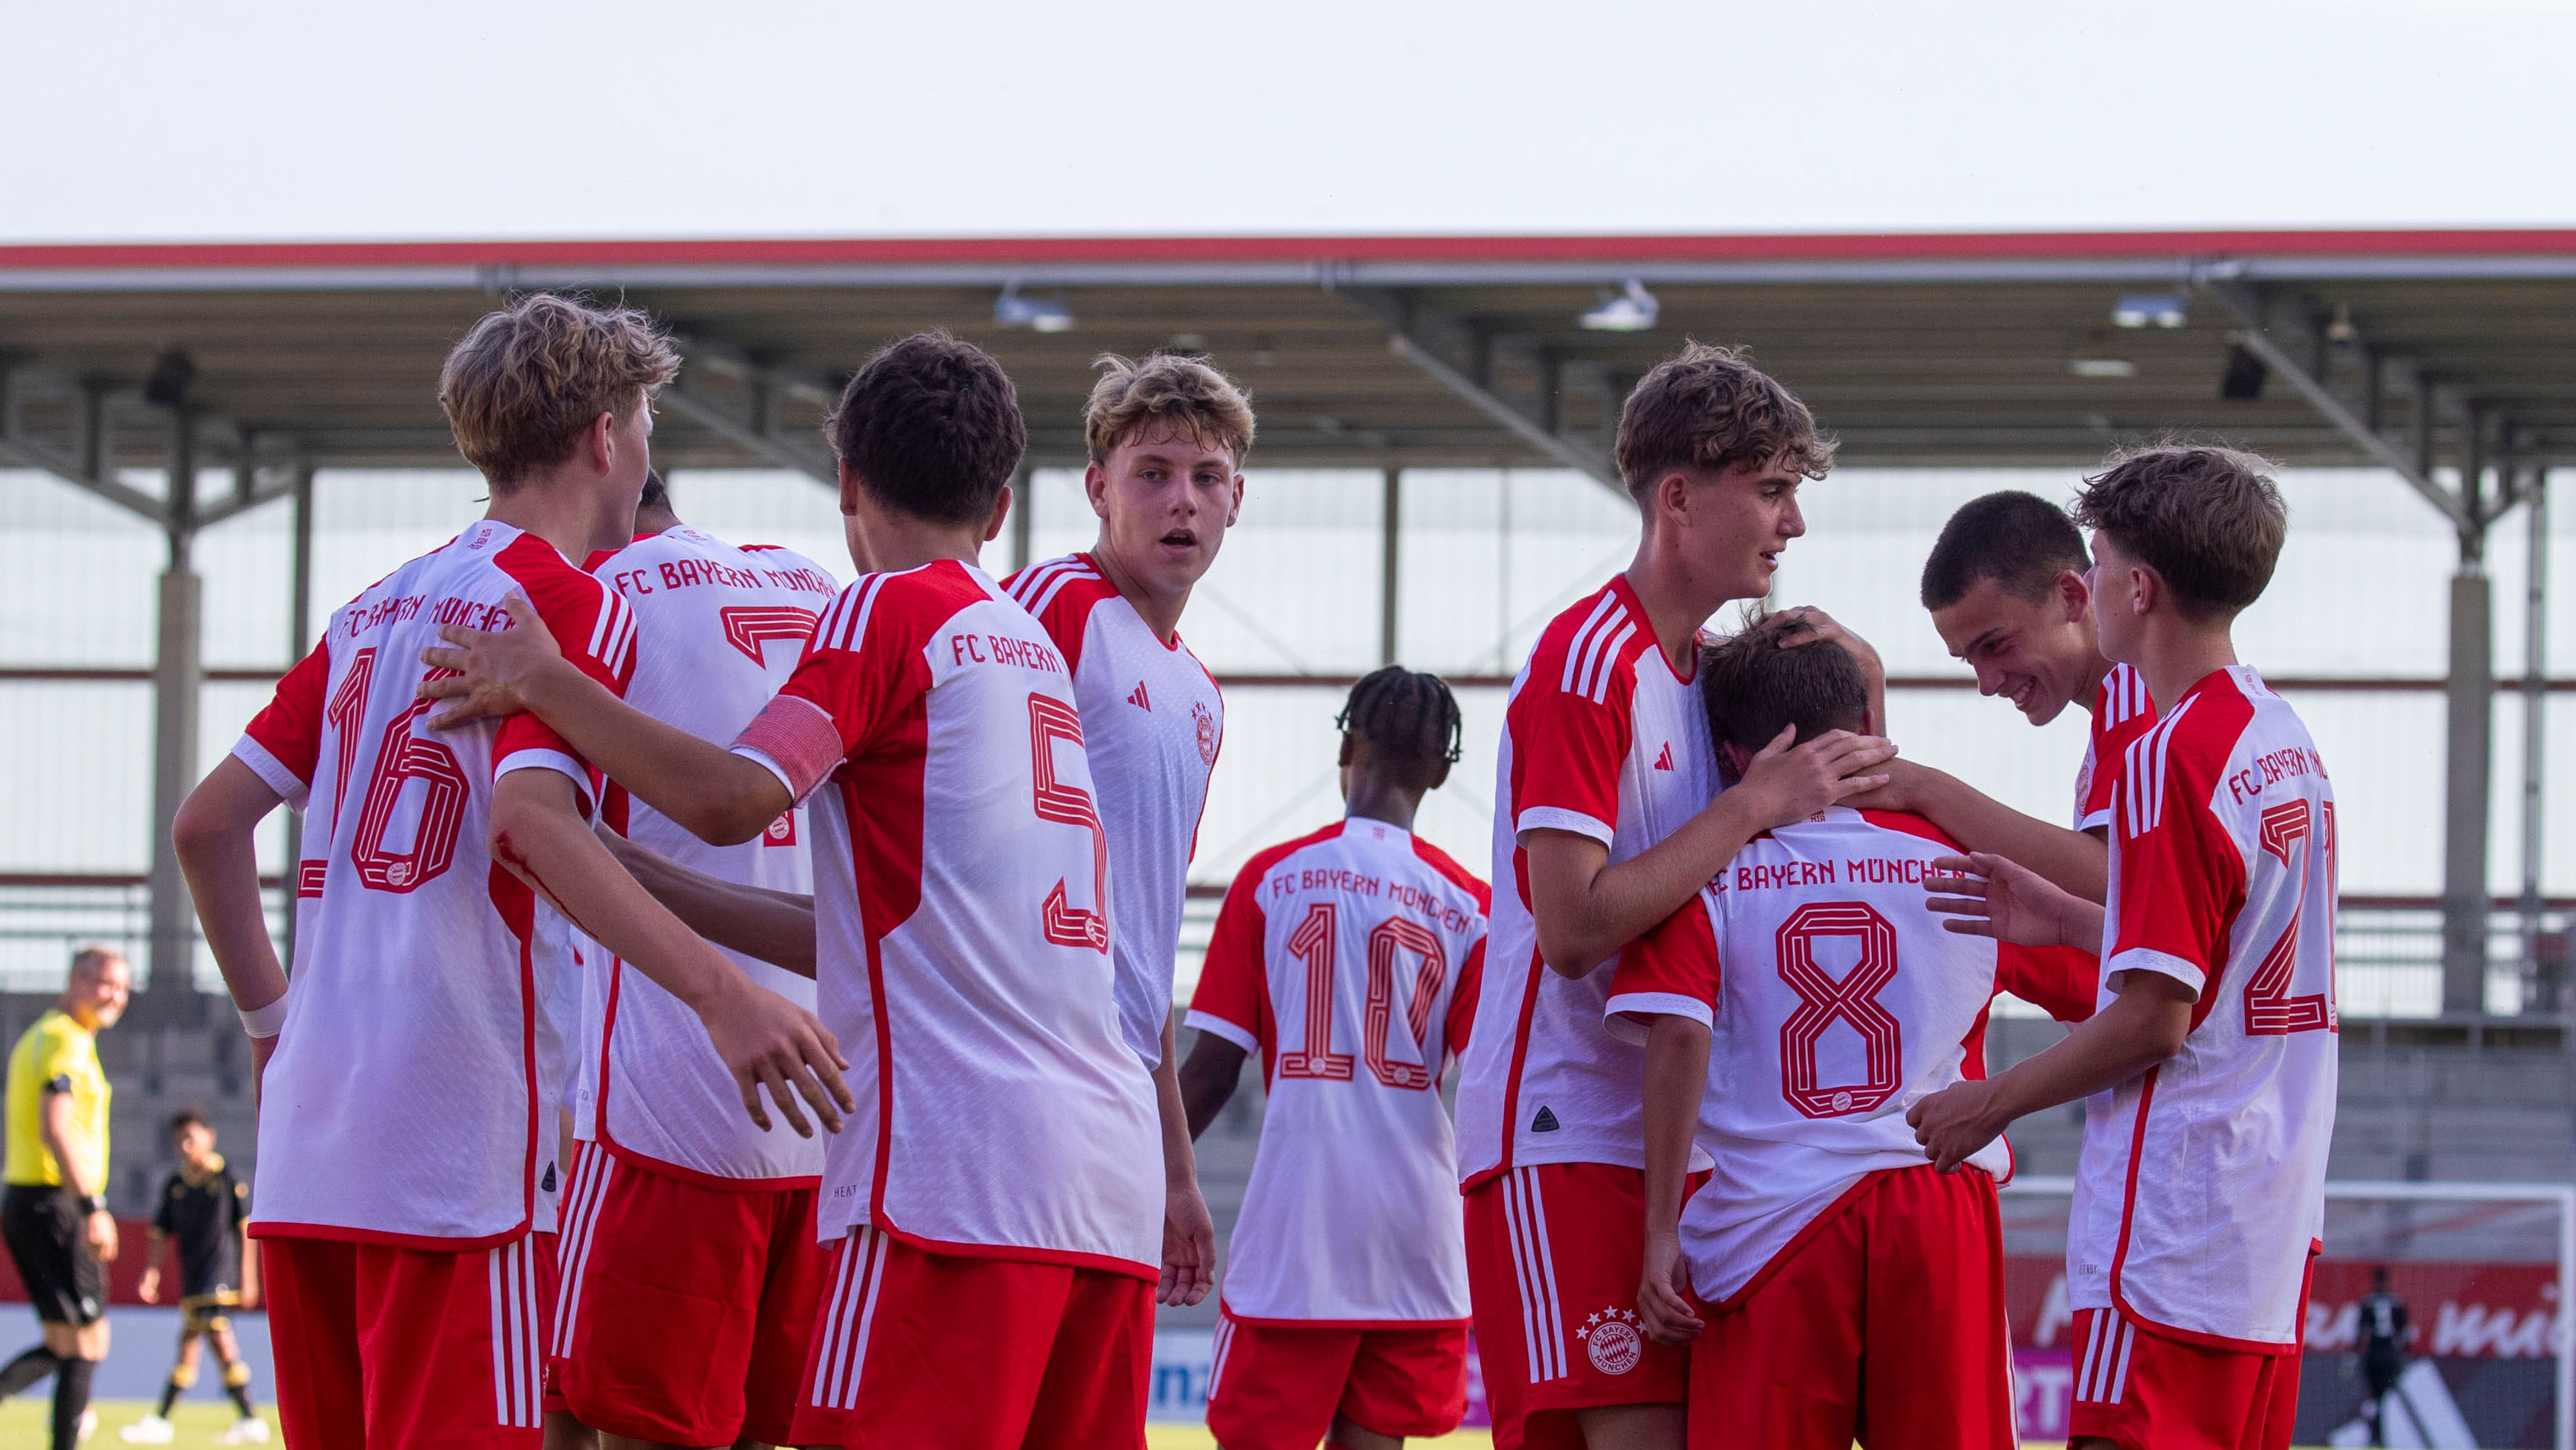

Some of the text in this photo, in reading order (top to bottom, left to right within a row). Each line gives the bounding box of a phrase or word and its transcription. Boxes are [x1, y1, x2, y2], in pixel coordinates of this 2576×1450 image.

[614, 569, 653, 598] FC
[658, 559, 763, 590] BAYERN
[338, 609, 367, 638] FC
[951, 634, 1063, 674] FC BAYERN
[298, 647, 471, 898] 16
[2228, 768, 2262, 806] FC
[2256, 747, 2310, 786] BAYERN
[1027, 692, 1108, 956] 5
[1272, 874, 1296, 899] FC
[1302, 868, 1380, 896] BAYERN
[1737, 859, 1836, 891] BAYERN
[2243, 797, 2339, 1038] 21
[1279, 902, 1446, 1092] 10
[1775, 901, 1903, 1119] 8
[834, 1184, 857, 1198] HEAT
[1593, 1326, 1636, 1347] FC BAYERN
